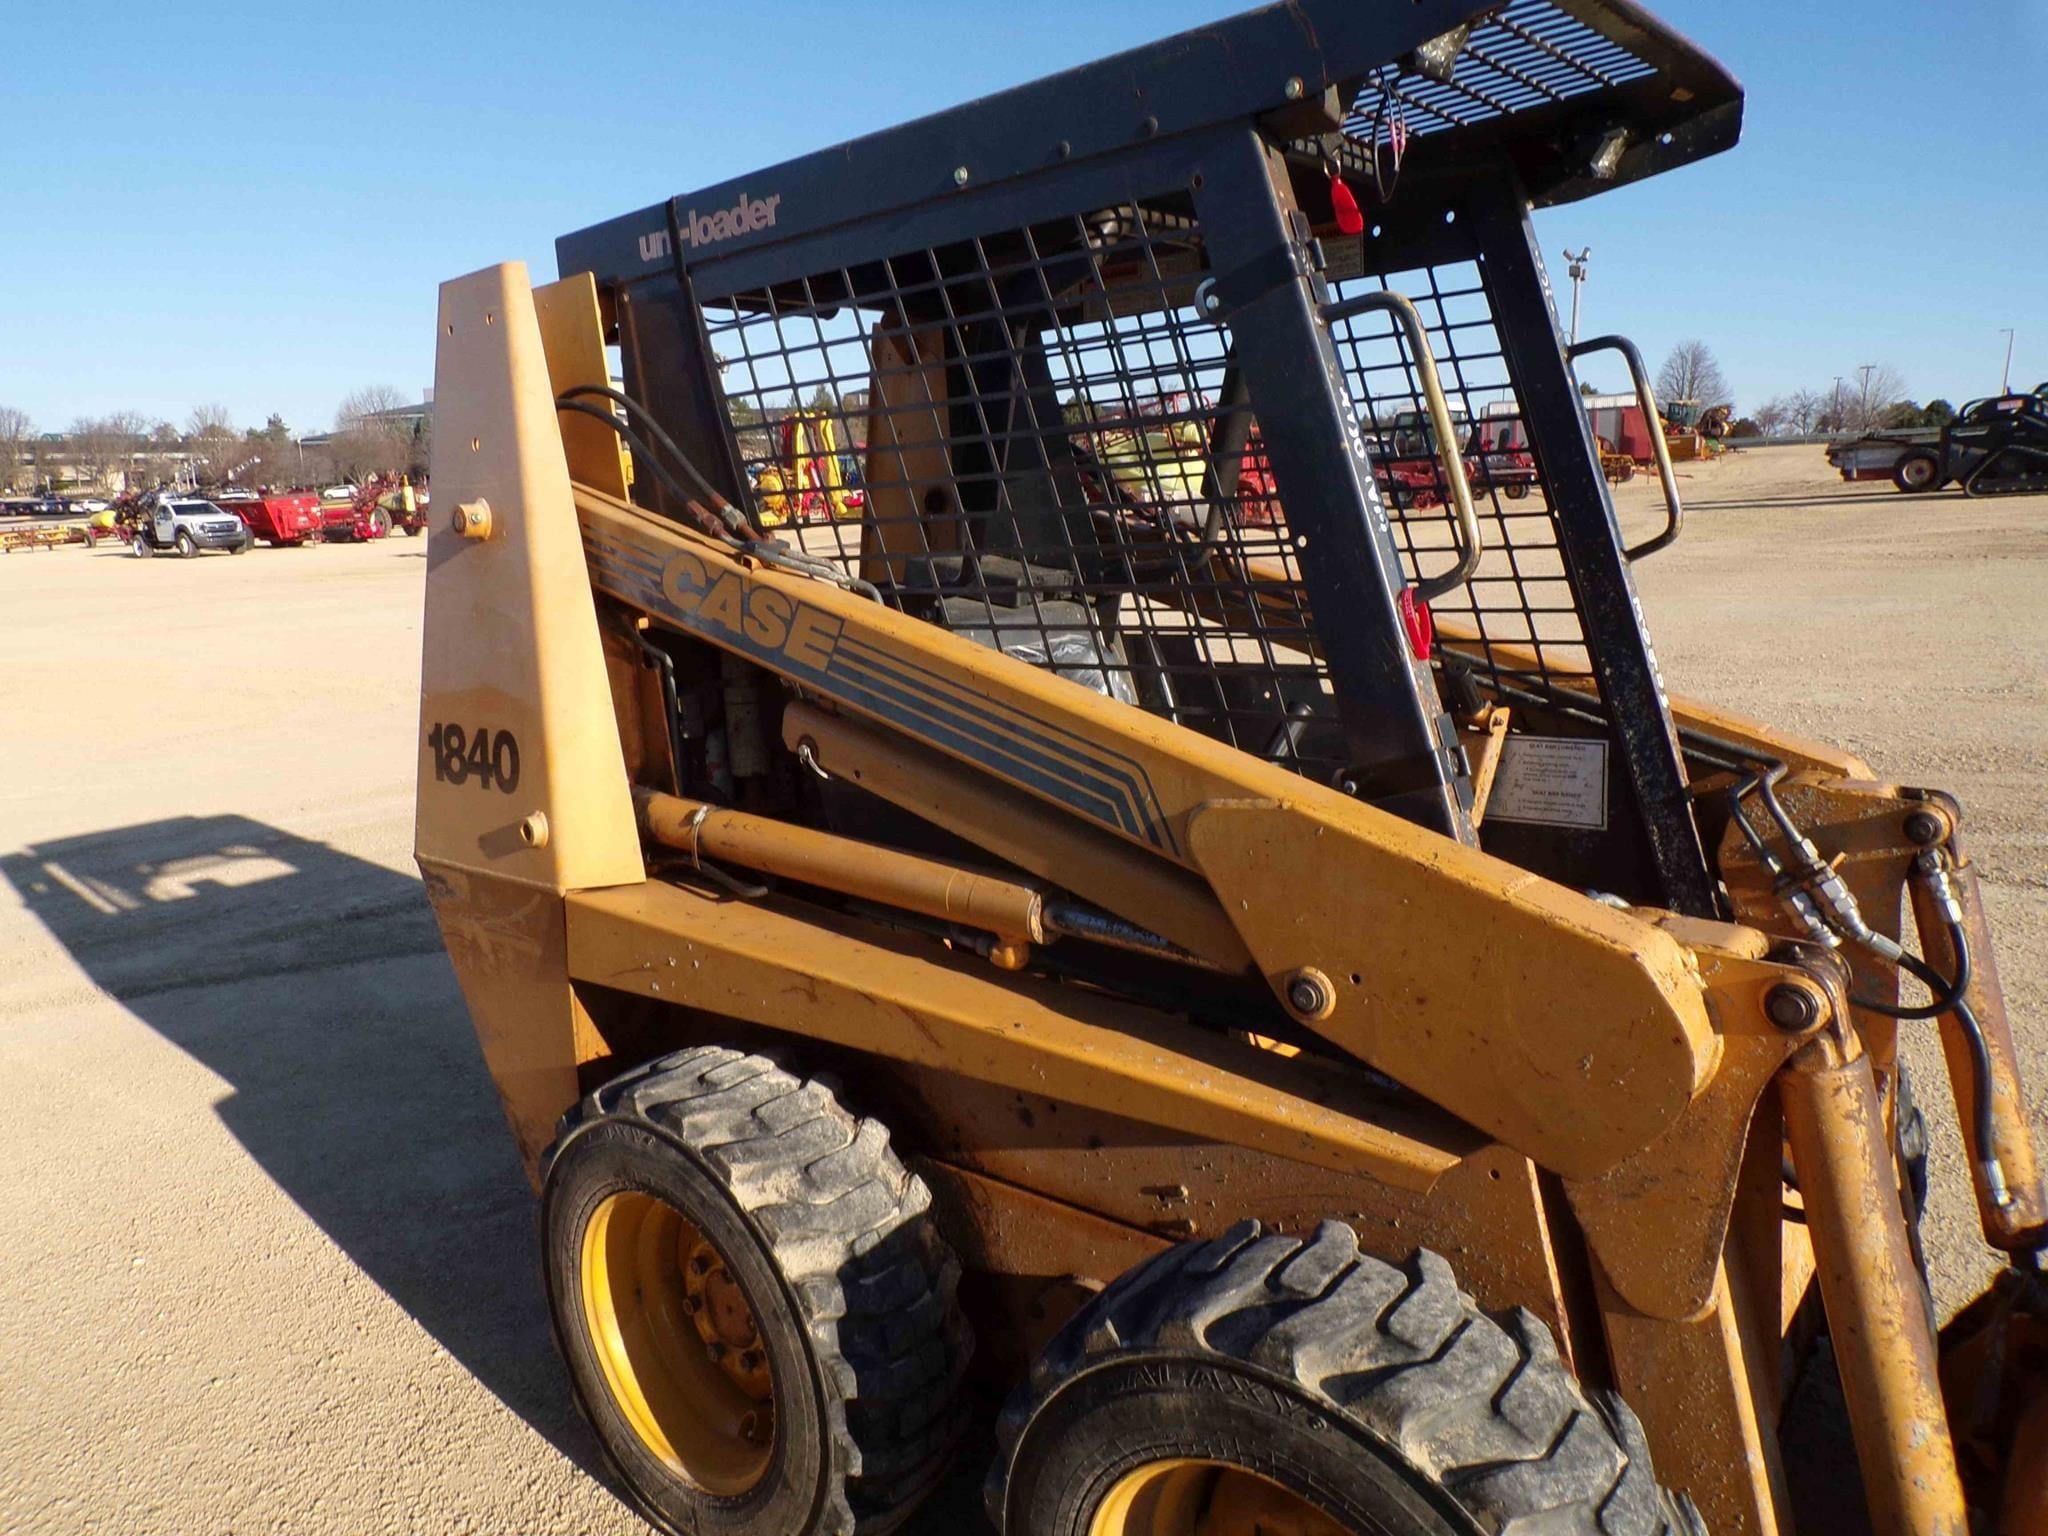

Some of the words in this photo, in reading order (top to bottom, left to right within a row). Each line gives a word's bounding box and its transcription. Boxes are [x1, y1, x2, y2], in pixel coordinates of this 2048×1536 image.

[639, 193, 781, 262] un-loader
[661, 550, 846, 674] CASE
[428, 722, 520, 794] 1840
